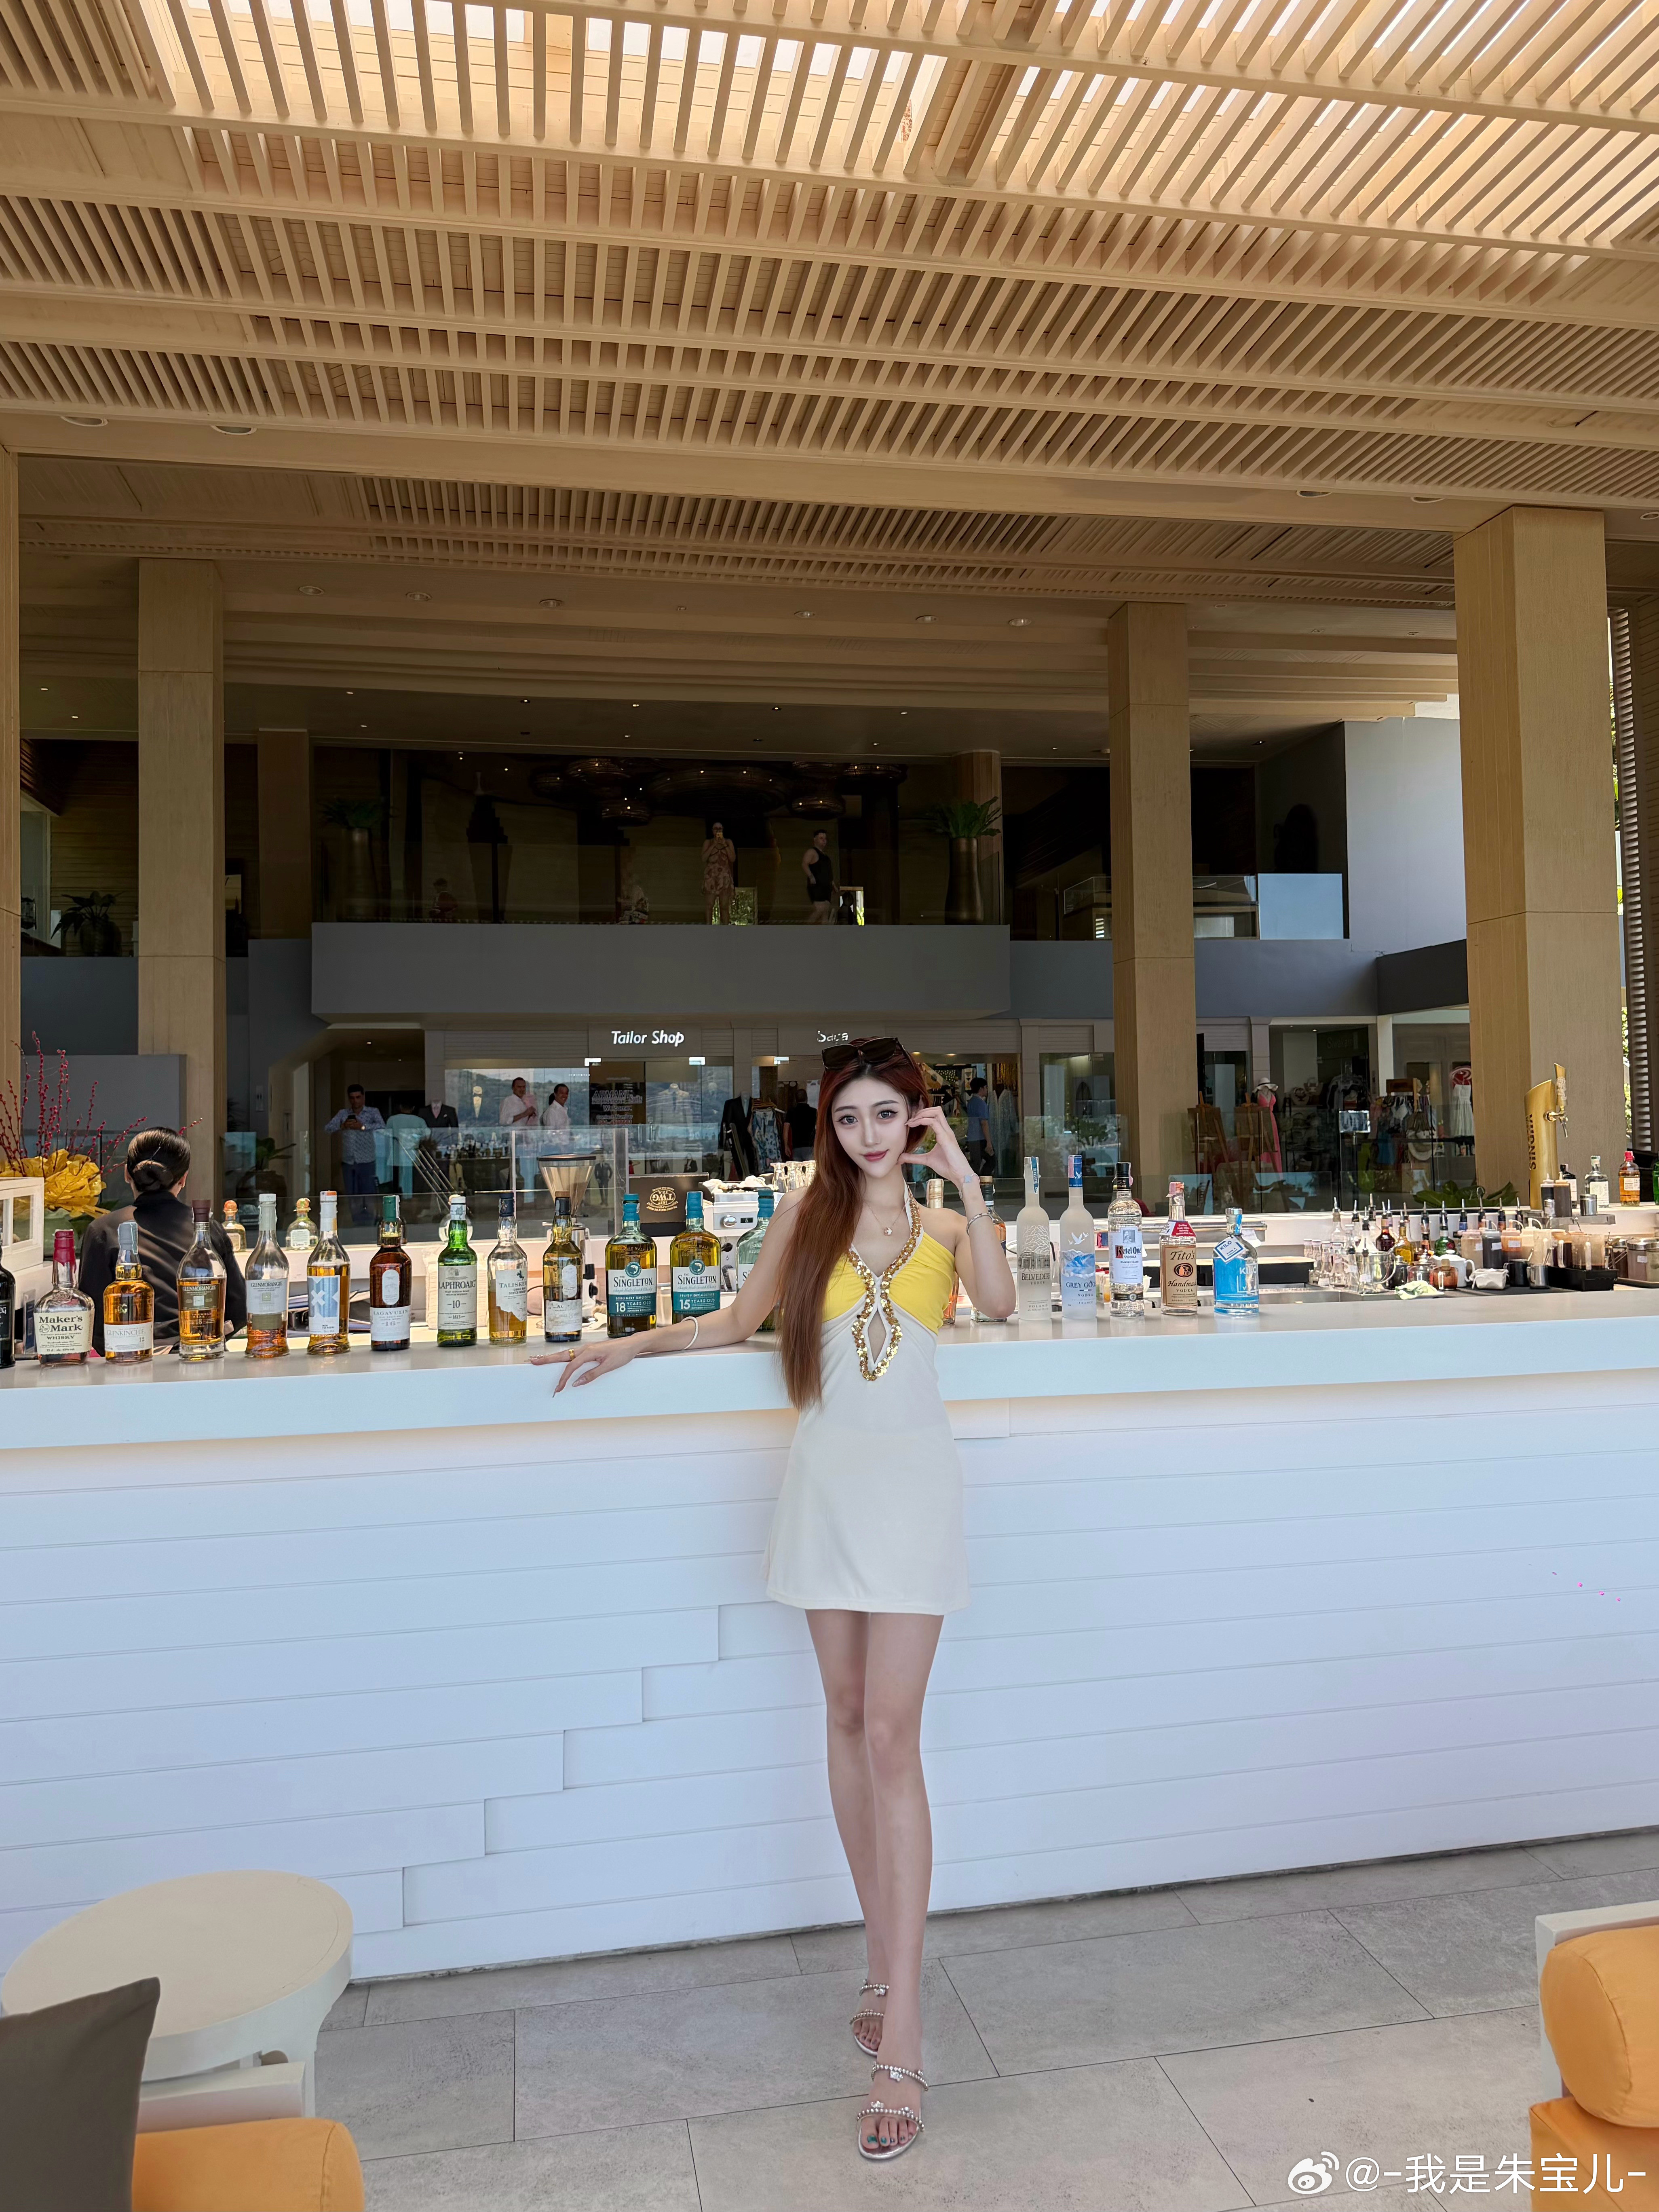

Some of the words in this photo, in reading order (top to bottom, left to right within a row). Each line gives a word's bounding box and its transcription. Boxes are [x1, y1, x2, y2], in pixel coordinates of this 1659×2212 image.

[611, 1031, 647, 1044] Tailor
[651, 1030, 684, 1047] Shop
[652, 1193, 674, 1201] TWG
[1219, 1240, 1232, 1251] KILO
[1170, 1250, 1195, 1260] Tito's
[1239, 1266, 1257, 1275] KILO
[439, 1280, 476, 1289] LAPHROAIG
[452, 1299, 460, 1308] 10
[616, 1302, 626, 1312] 18
[680, 1299, 690, 1310] 15
[39, 1315, 83, 1323] Maker's
[50, 1324, 82, 1332] Mark
